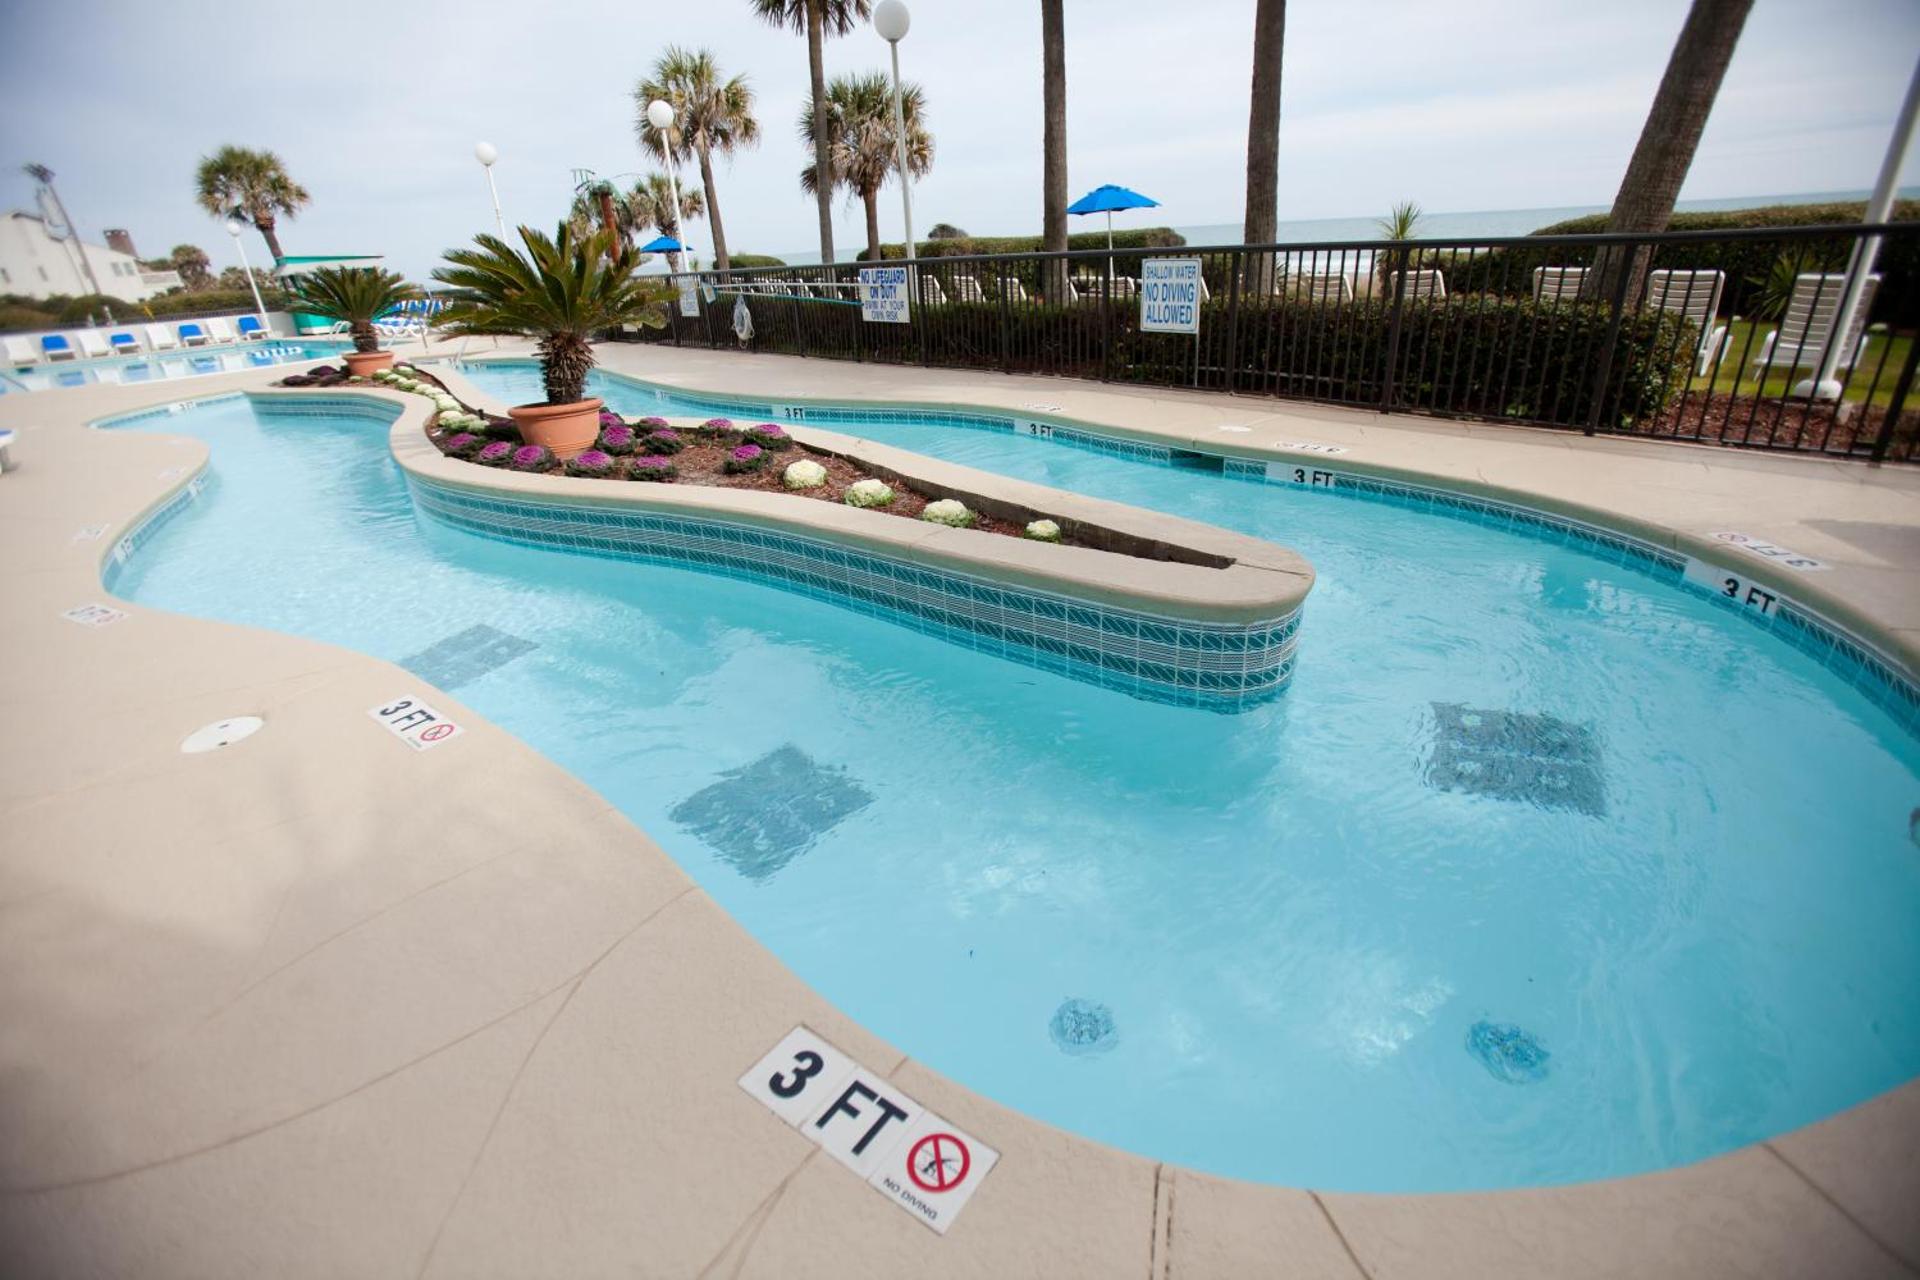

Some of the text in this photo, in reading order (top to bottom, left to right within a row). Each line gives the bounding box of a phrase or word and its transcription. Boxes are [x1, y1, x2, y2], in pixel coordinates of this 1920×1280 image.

[860, 269, 906, 284] NO LIFEGUARD
[1146, 265, 1196, 279] SHALLOW WATER
[1145, 283, 1195, 303] NO DIVING
[1145, 304, 1193, 325] ALLOWED
[784, 407, 804, 420] 3 FT
[1030, 423, 1052, 438] 3 FT
[1293, 468, 1333, 488] 3 FT
[1721, 577, 1777, 614] 3 FT
[379, 700, 436, 732] 3 FT
[768, 1050, 909, 1156] 3 FT
[882, 1176, 938, 1220] NO DIVING
